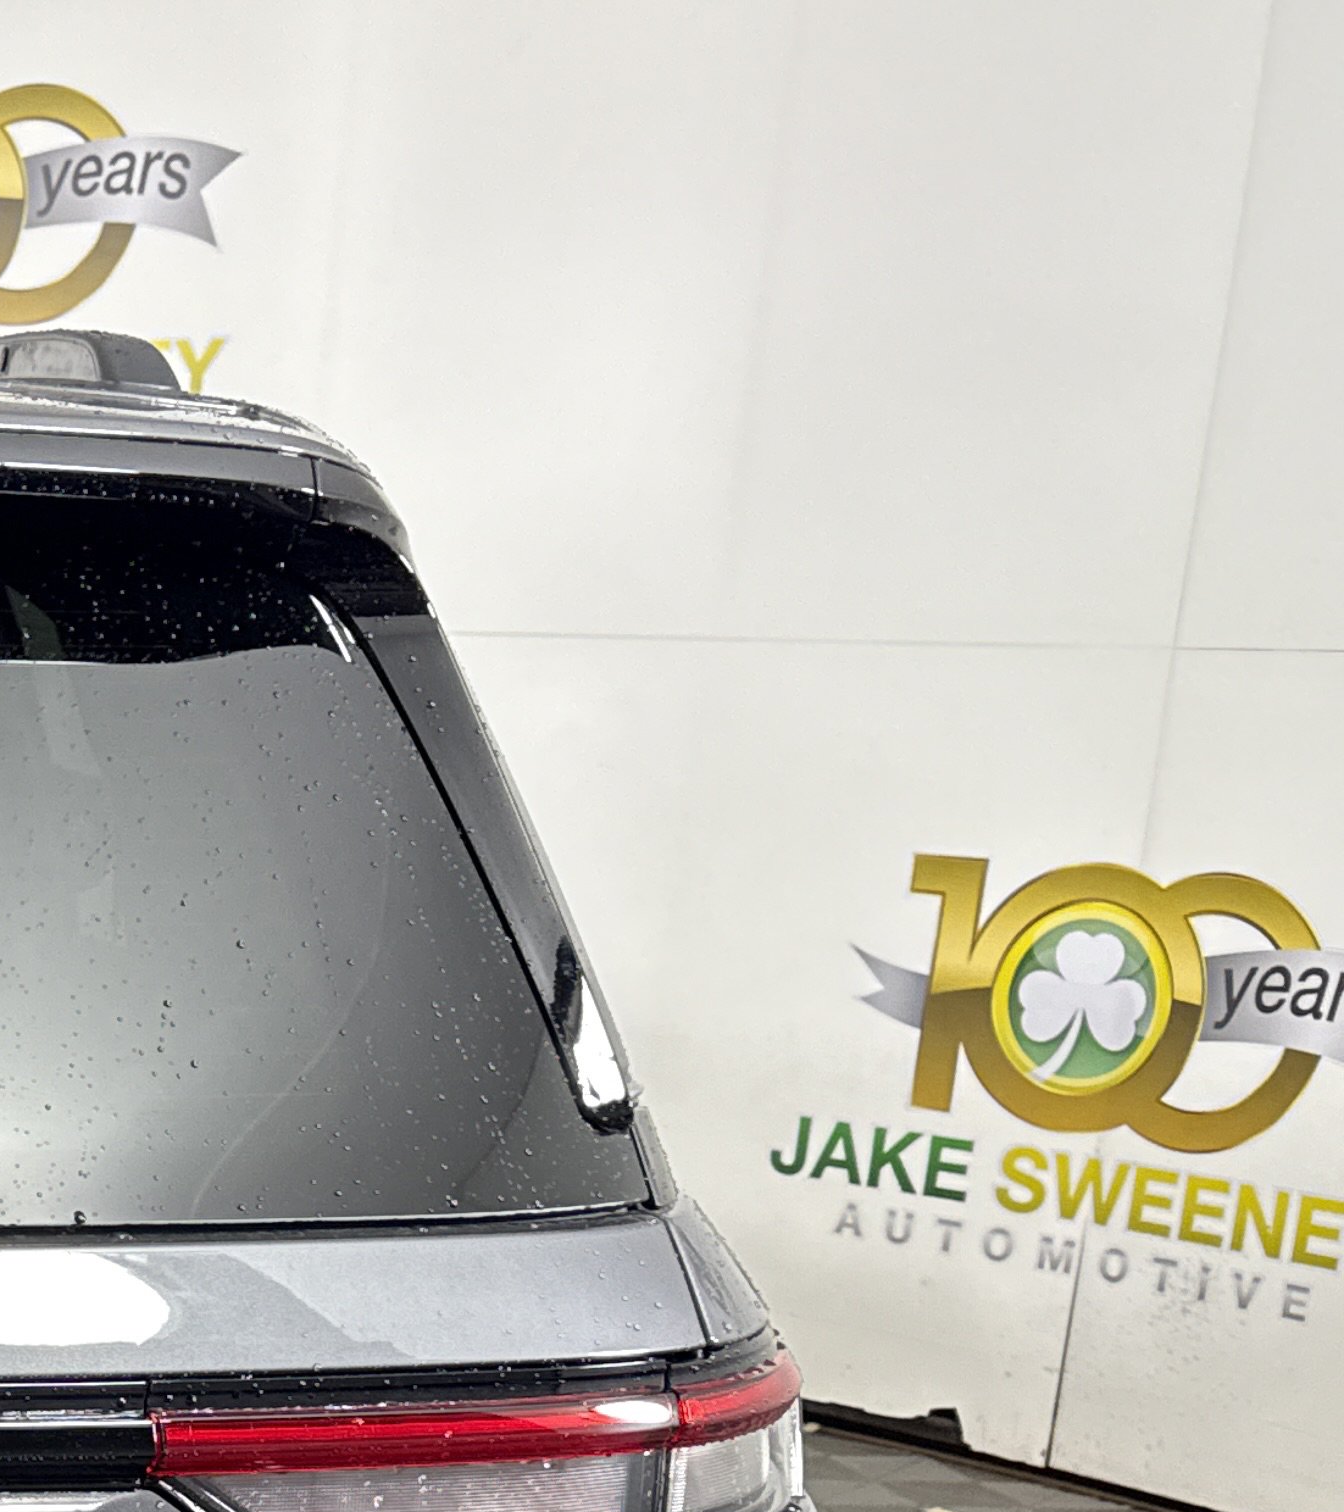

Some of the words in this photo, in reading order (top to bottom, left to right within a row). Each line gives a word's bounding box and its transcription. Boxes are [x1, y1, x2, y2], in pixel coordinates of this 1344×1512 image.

[37, 150, 191, 217] years
[910, 852, 1322, 1155] 100
[770, 1115, 974, 1201] JAKE
[834, 1202, 1311, 1322] AUTOMOTIVE
